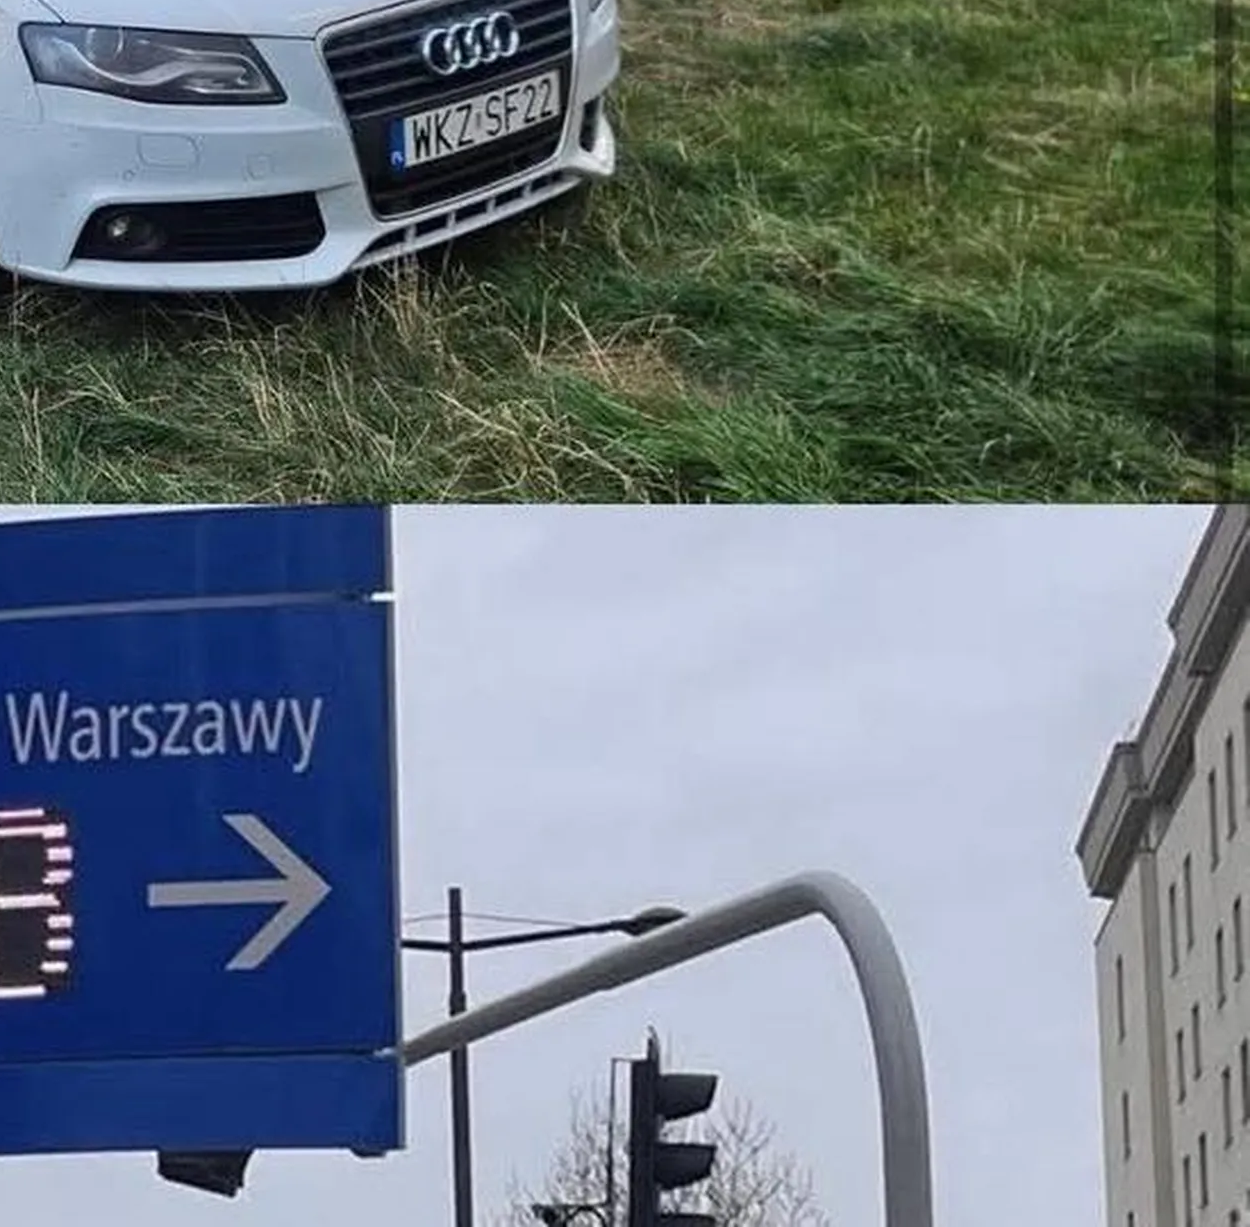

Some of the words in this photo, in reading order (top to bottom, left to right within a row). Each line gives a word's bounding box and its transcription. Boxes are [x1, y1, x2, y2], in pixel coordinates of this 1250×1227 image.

[412, 103, 474, 160] WKZ
[485, 78, 553, 137] SF22
[5, 690, 323, 774] Warszawy
